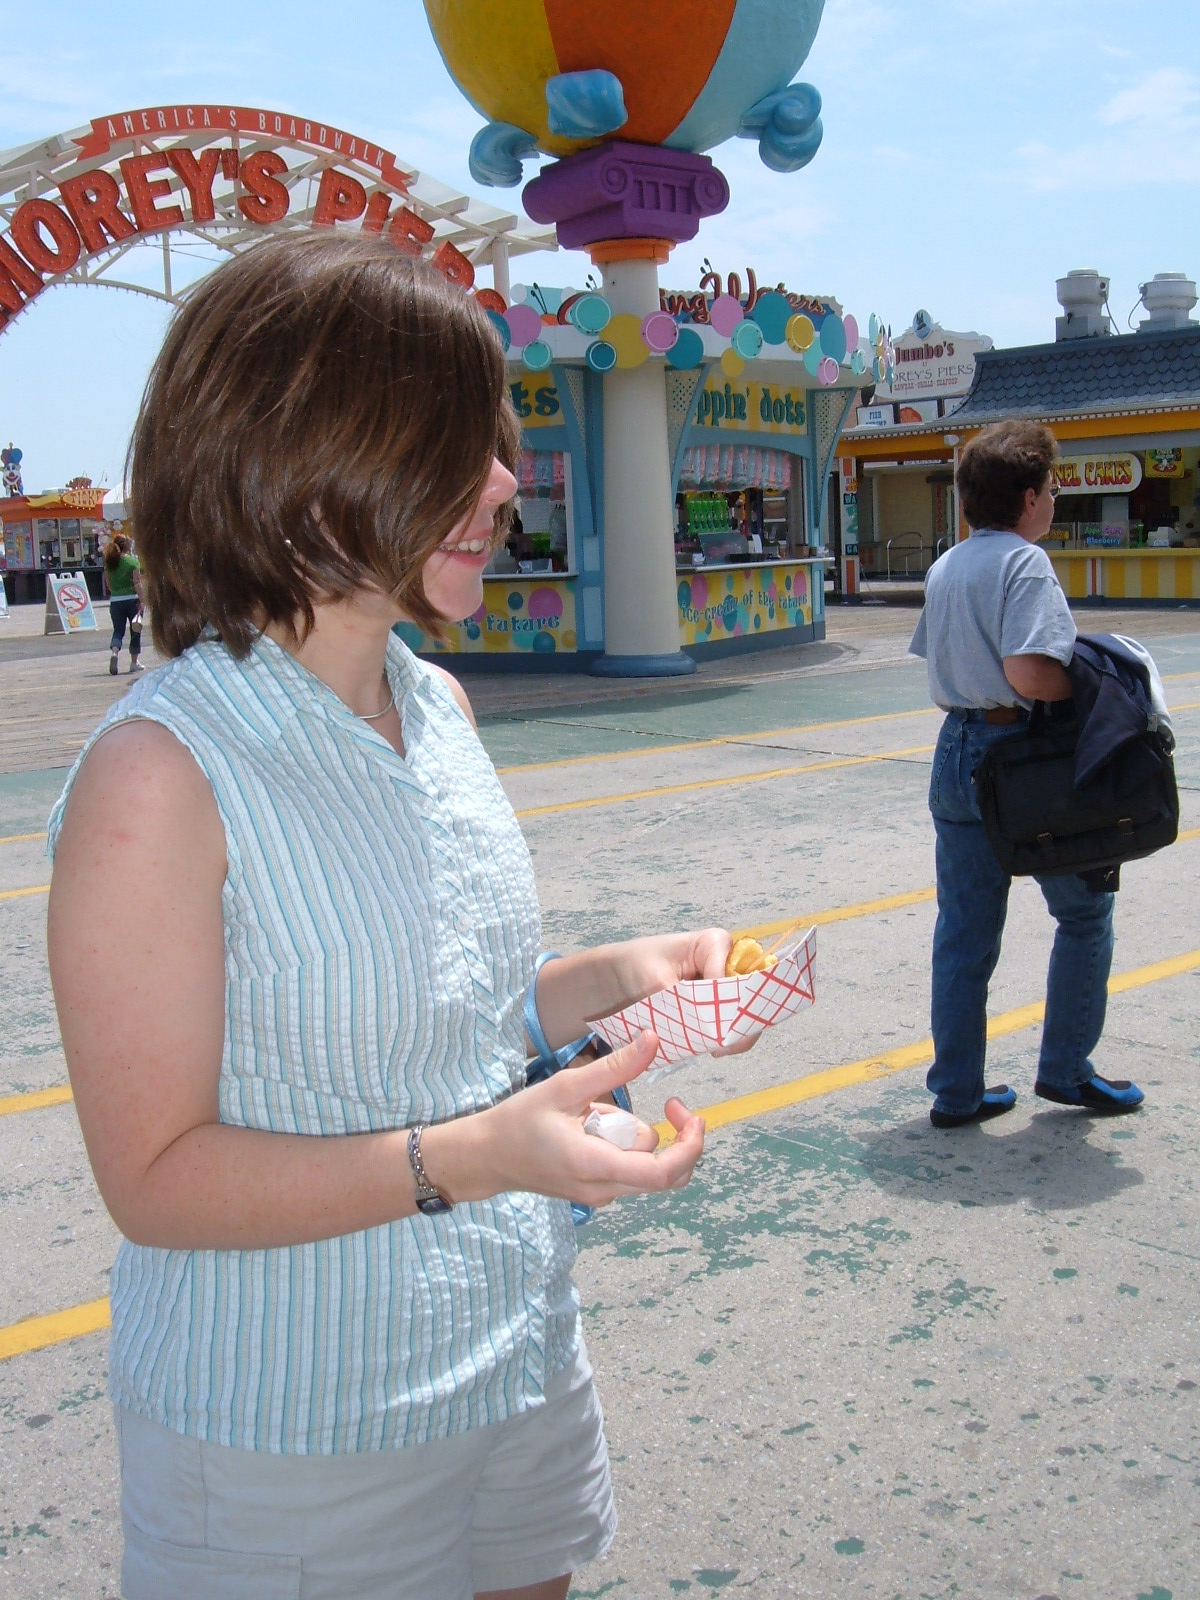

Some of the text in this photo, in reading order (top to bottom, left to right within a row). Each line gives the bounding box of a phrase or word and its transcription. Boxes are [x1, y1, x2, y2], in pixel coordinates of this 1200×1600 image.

[107, 108, 385, 167] AMERICA'S BOARDWALK
[0, 148, 290, 331] MOREY'S
[938, 363, 974, 377] PIERS
[760, 387, 806, 426] dots
[1084, 460, 1133, 486] CAKES
[742, 589, 754, 606] of
[758, 591, 775, 610] the
[778, 592, 808, 610] future
[486, 614, 561, 632] future
